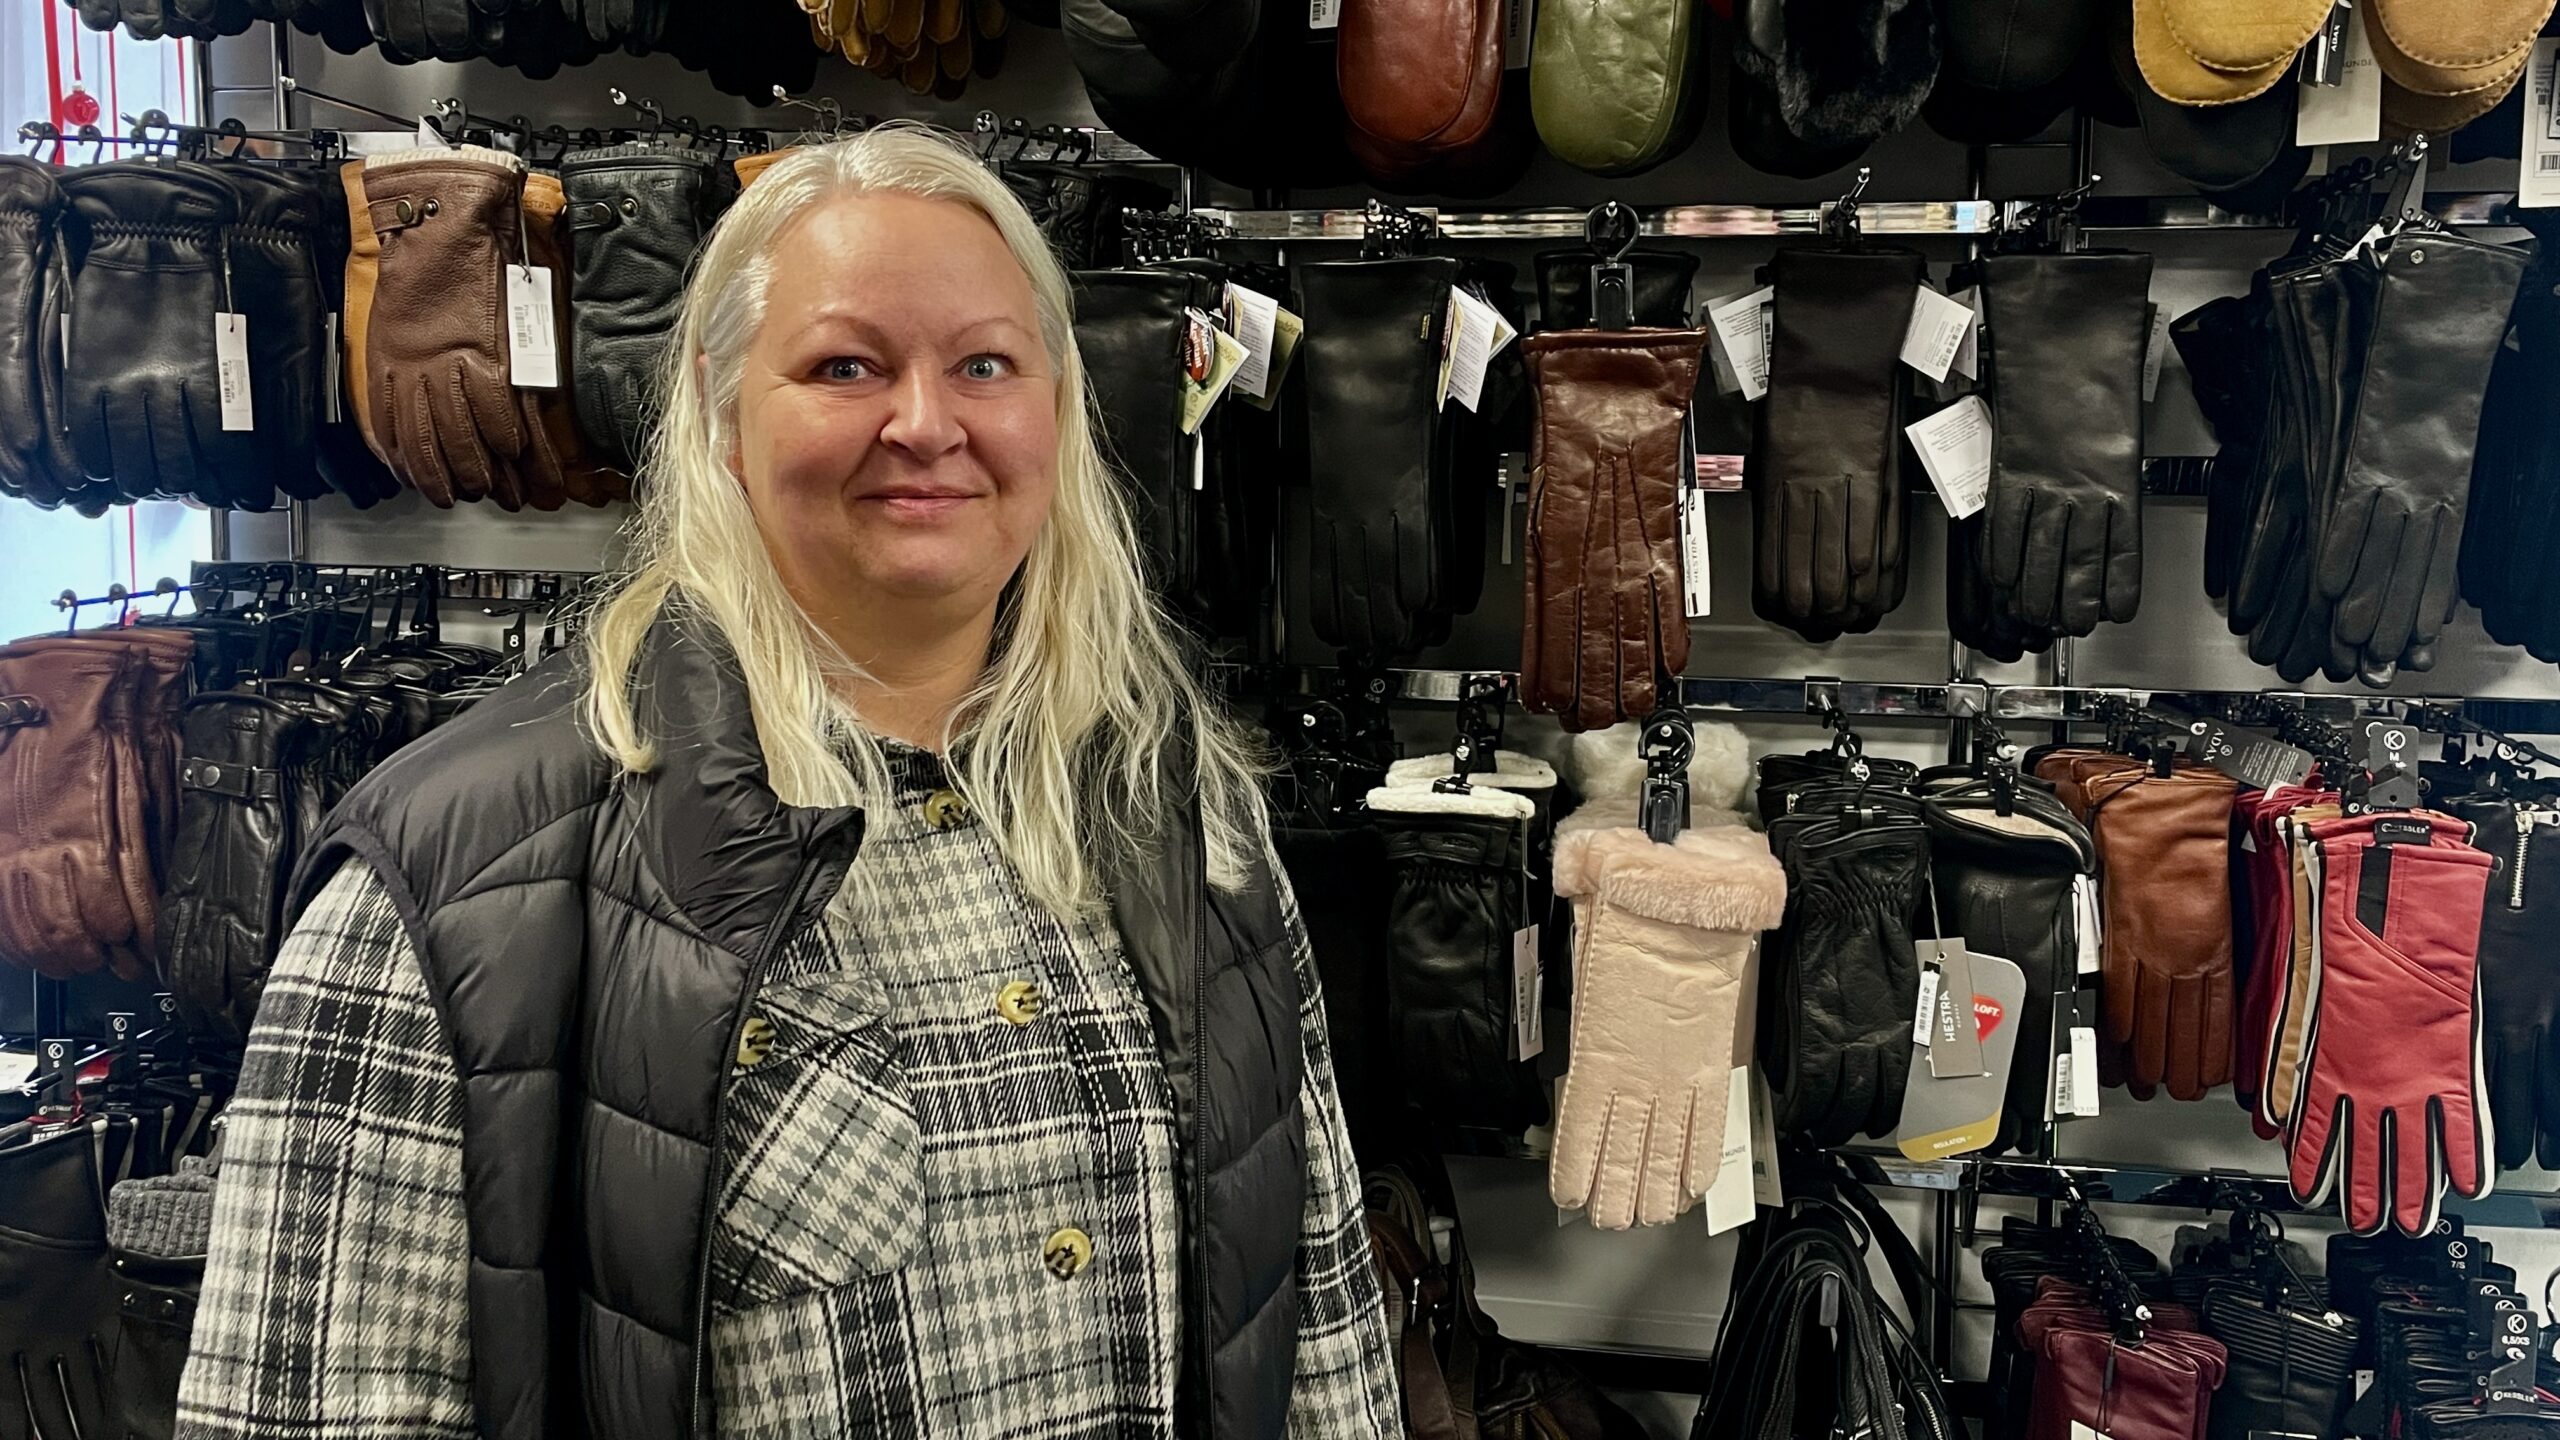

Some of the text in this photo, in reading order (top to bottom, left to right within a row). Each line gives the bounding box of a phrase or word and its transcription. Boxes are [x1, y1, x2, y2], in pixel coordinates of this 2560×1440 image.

[2330, 24, 2341, 52] ADAX
[509, 634, 520, 648] 8
[2203, 727, 2225, 763] ADAX
[2389, 751, 2400, 761] M
[1938, 989, 1957, 1042] HESTRA
[2450, 1260, 2466, 1270] 7/S
